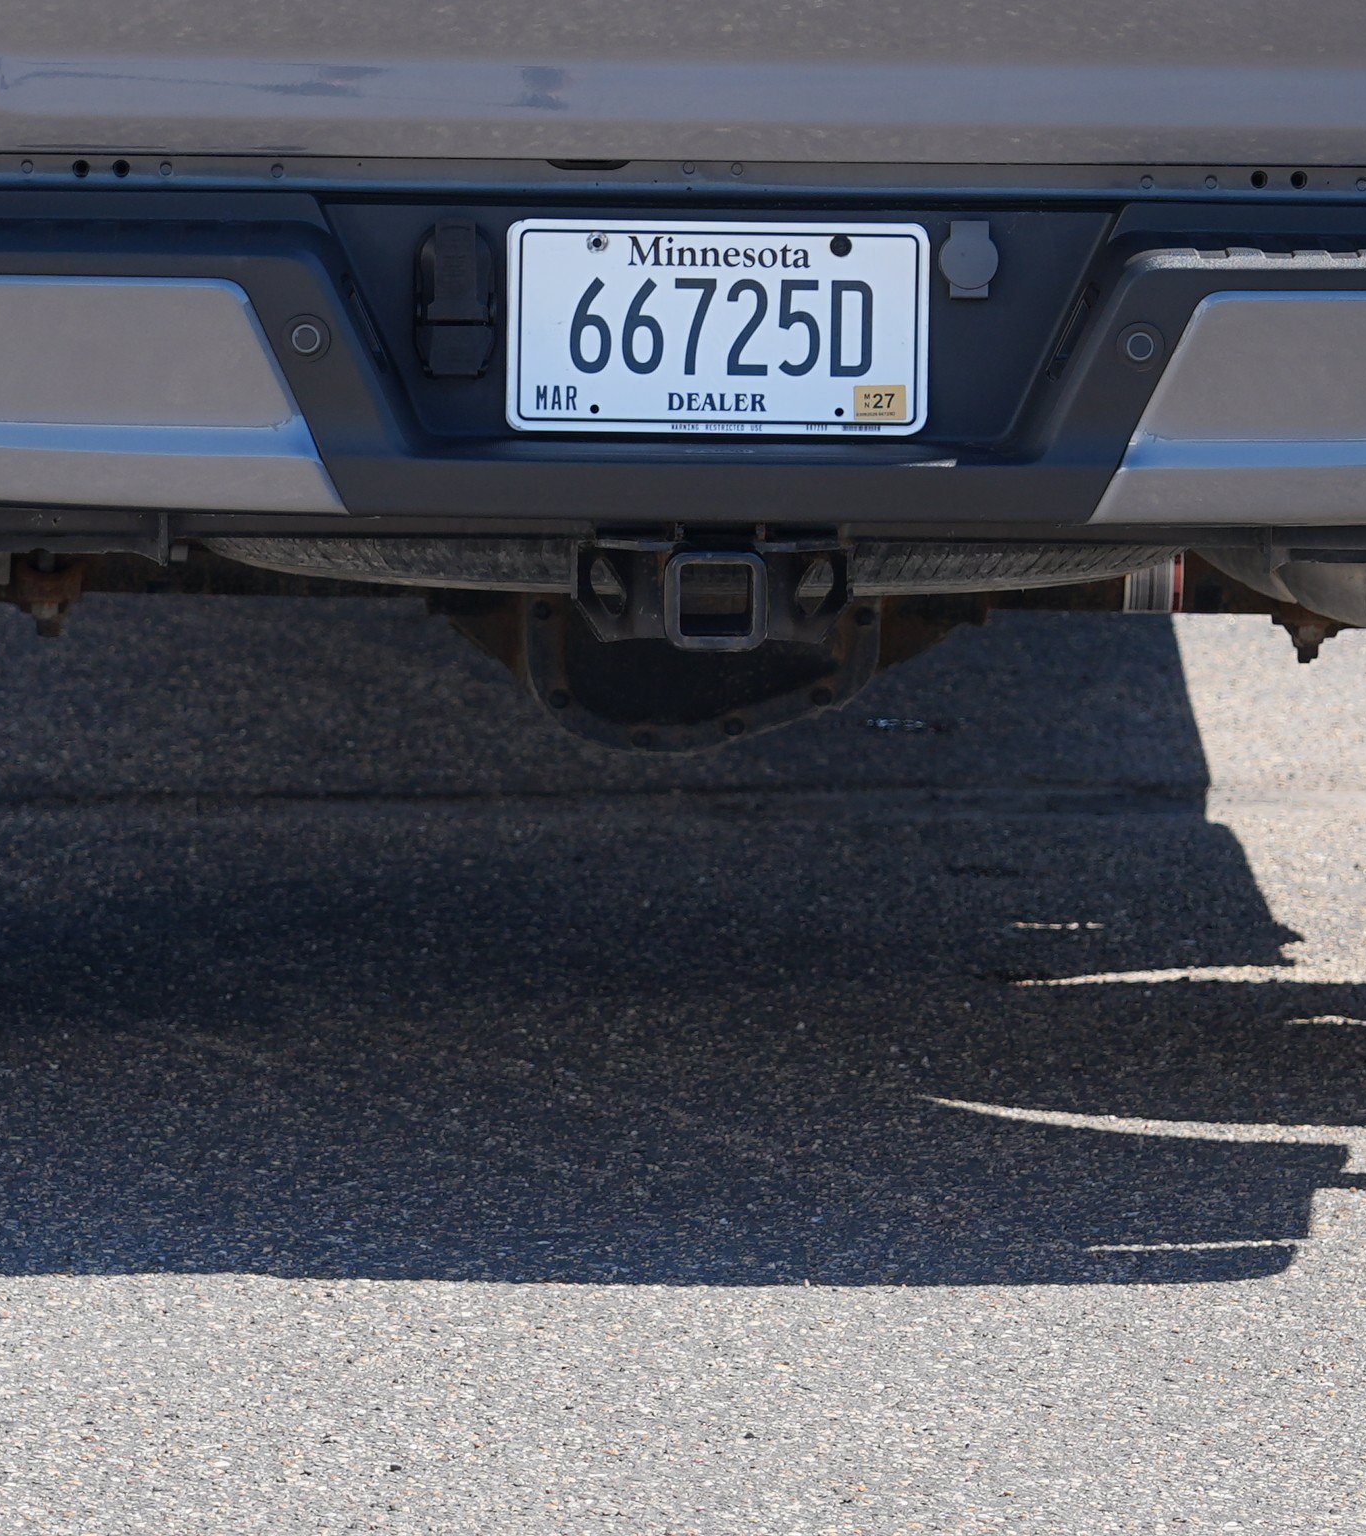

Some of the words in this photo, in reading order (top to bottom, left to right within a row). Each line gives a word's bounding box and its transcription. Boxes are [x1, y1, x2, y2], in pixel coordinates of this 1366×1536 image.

[627, 235, 812, 269] Minnesota
[569, 277, 874, 378] 66725D
[535, 385, 578, 412] MAR
[667, 392, 767, 413] DEALER
[873, 393, 896, 409] 27
